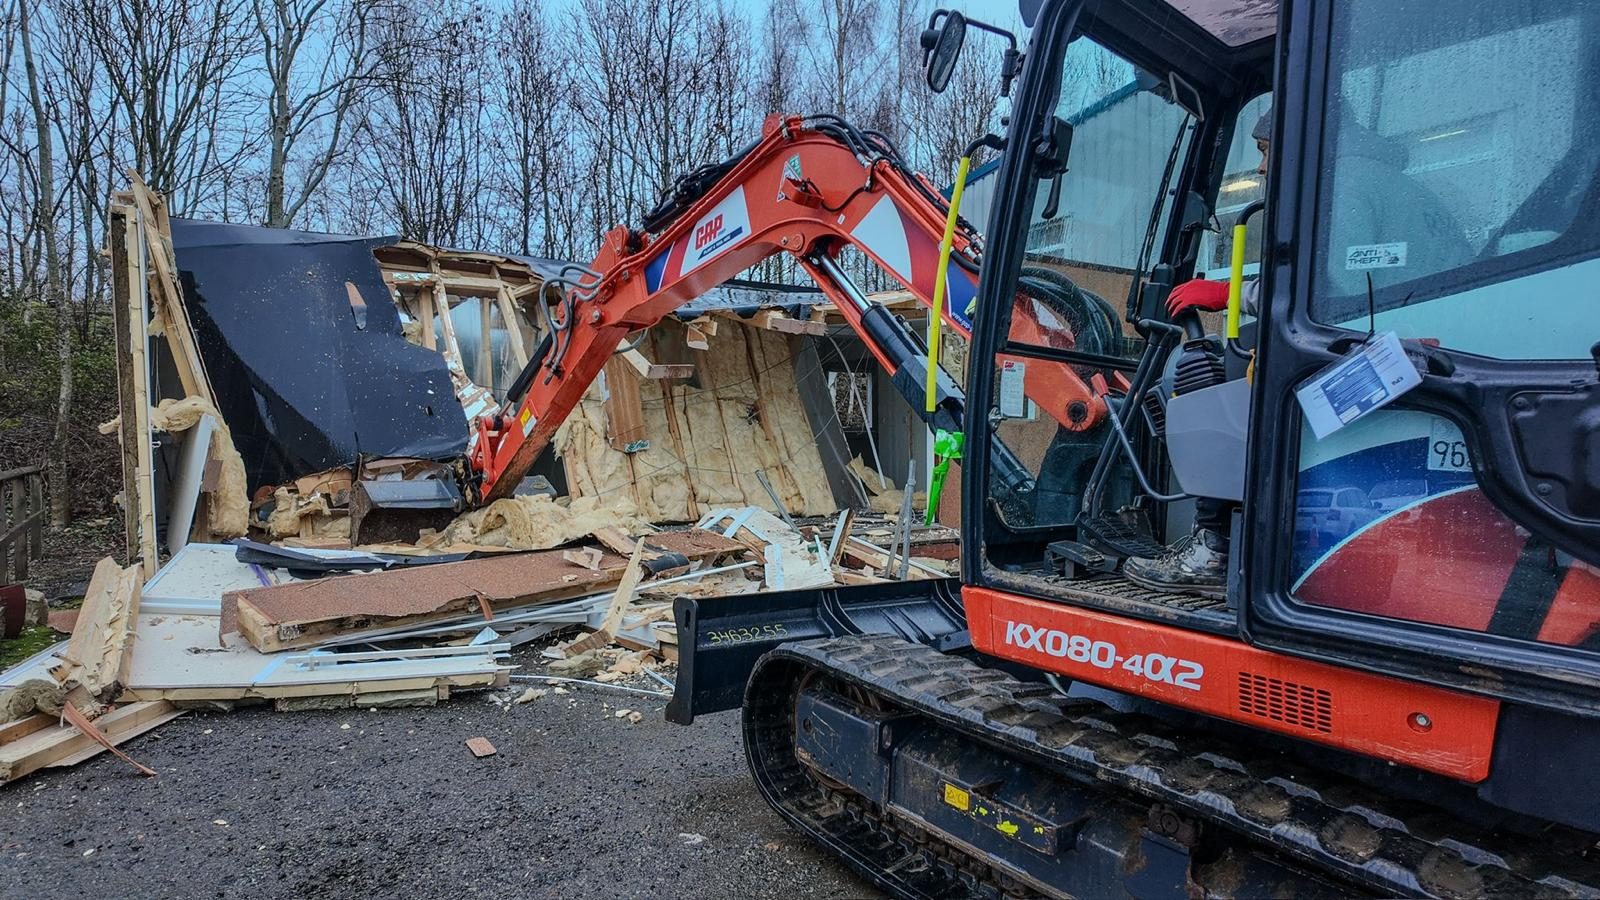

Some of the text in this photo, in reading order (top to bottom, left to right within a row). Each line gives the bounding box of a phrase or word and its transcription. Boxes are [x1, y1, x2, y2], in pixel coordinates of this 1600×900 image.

[695, 213, 723, 251] GAP
[1348, 256, 1383, 265] THEFT
[707, 624, 788, 645] 3463255
